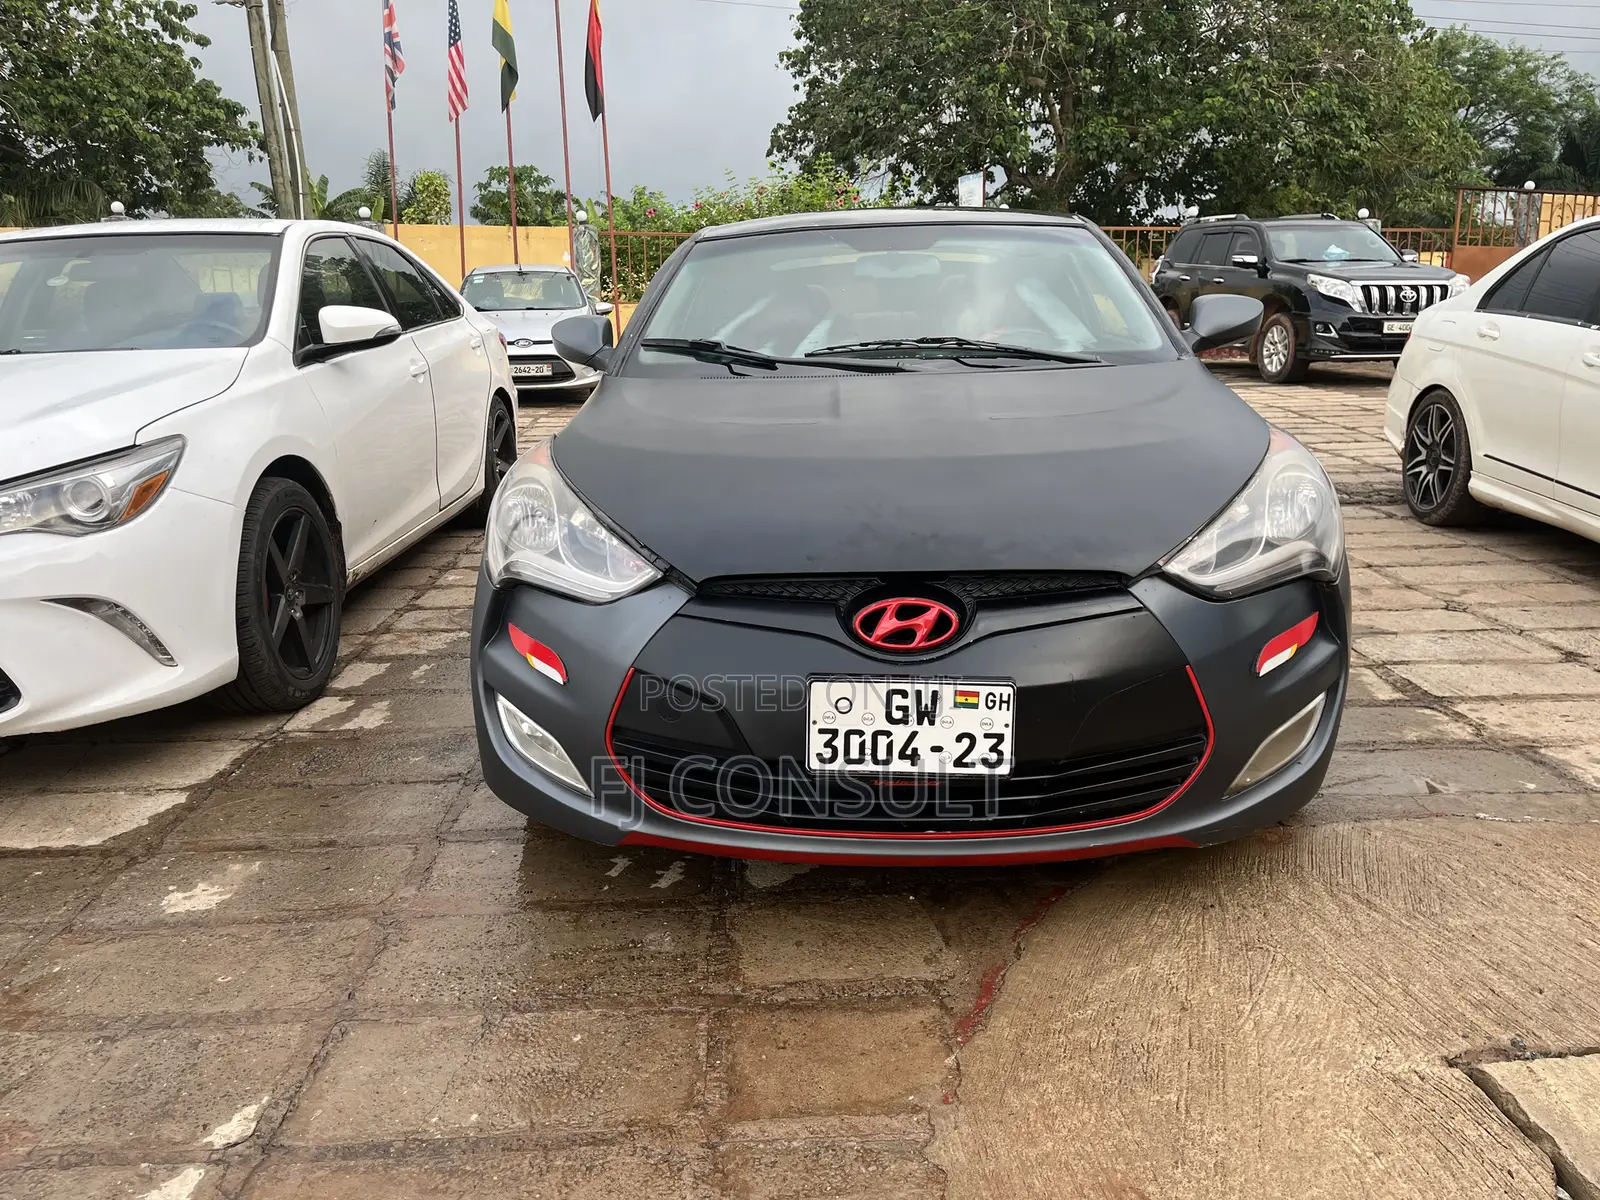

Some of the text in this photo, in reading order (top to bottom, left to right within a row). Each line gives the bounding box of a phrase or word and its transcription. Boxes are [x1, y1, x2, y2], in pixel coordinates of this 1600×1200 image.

[885, 688, 939, 726] GW
[985, 692, 1011, 711] GH
[816, 728, 1005, 769] 3004-23
